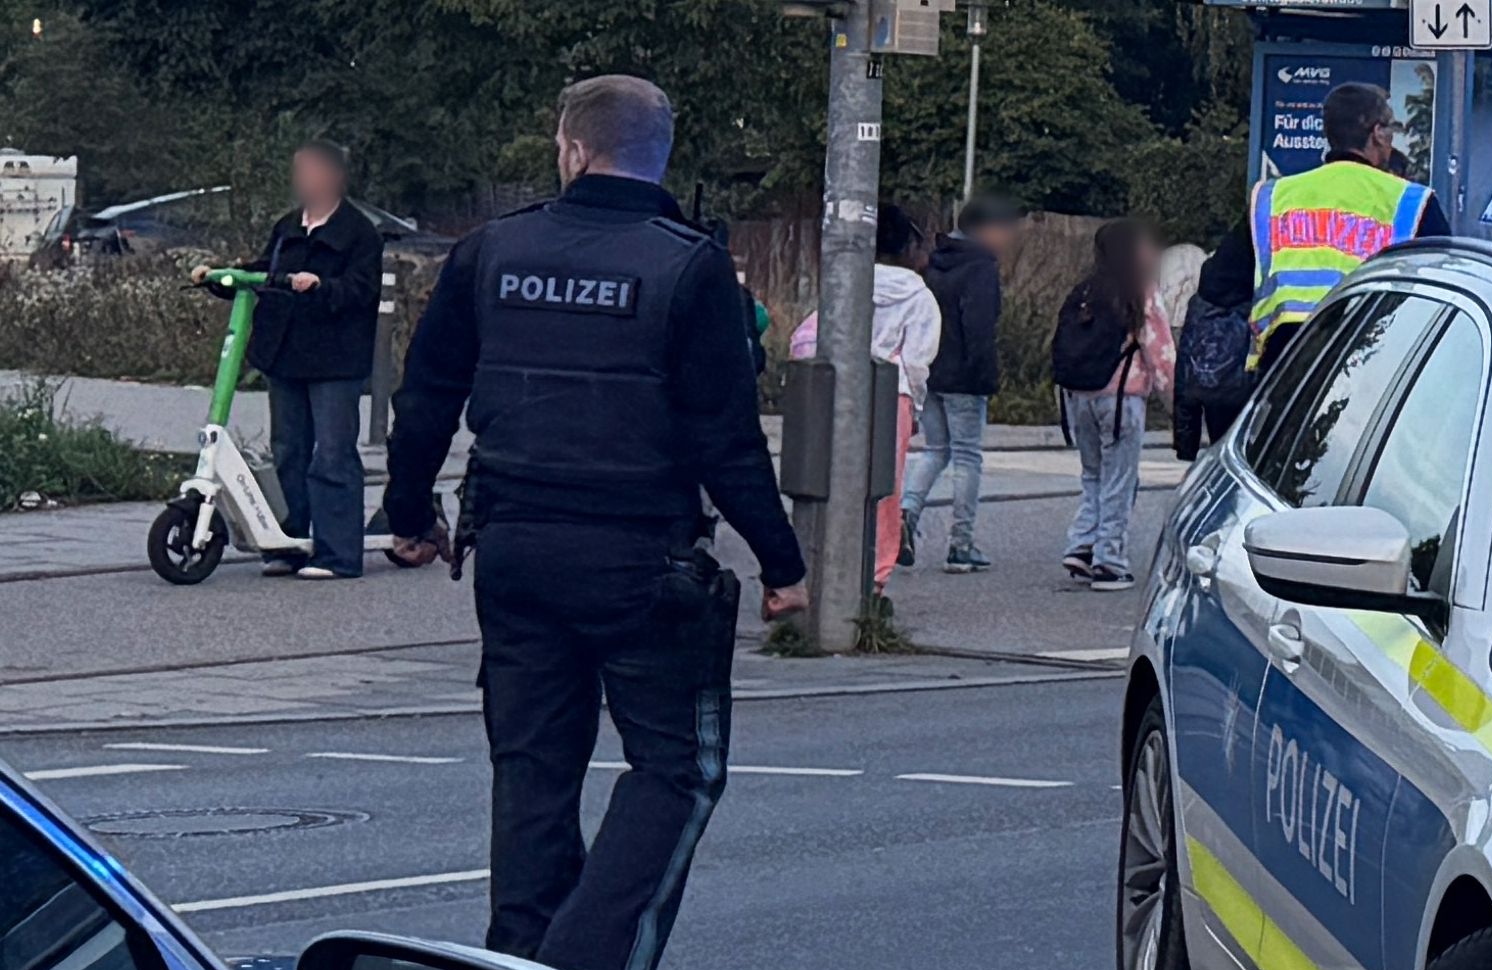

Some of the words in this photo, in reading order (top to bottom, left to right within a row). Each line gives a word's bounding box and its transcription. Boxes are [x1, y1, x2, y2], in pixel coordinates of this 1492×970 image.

[1294, 67, 1331, 78] MVG
[1274, 113, 1299, 130] Für
[1279, 209, 1388, 260] POLIZEI
[499, 274, 630, 308] POLIZEI
[1266, 723, 1360, 905] POLIZEI
